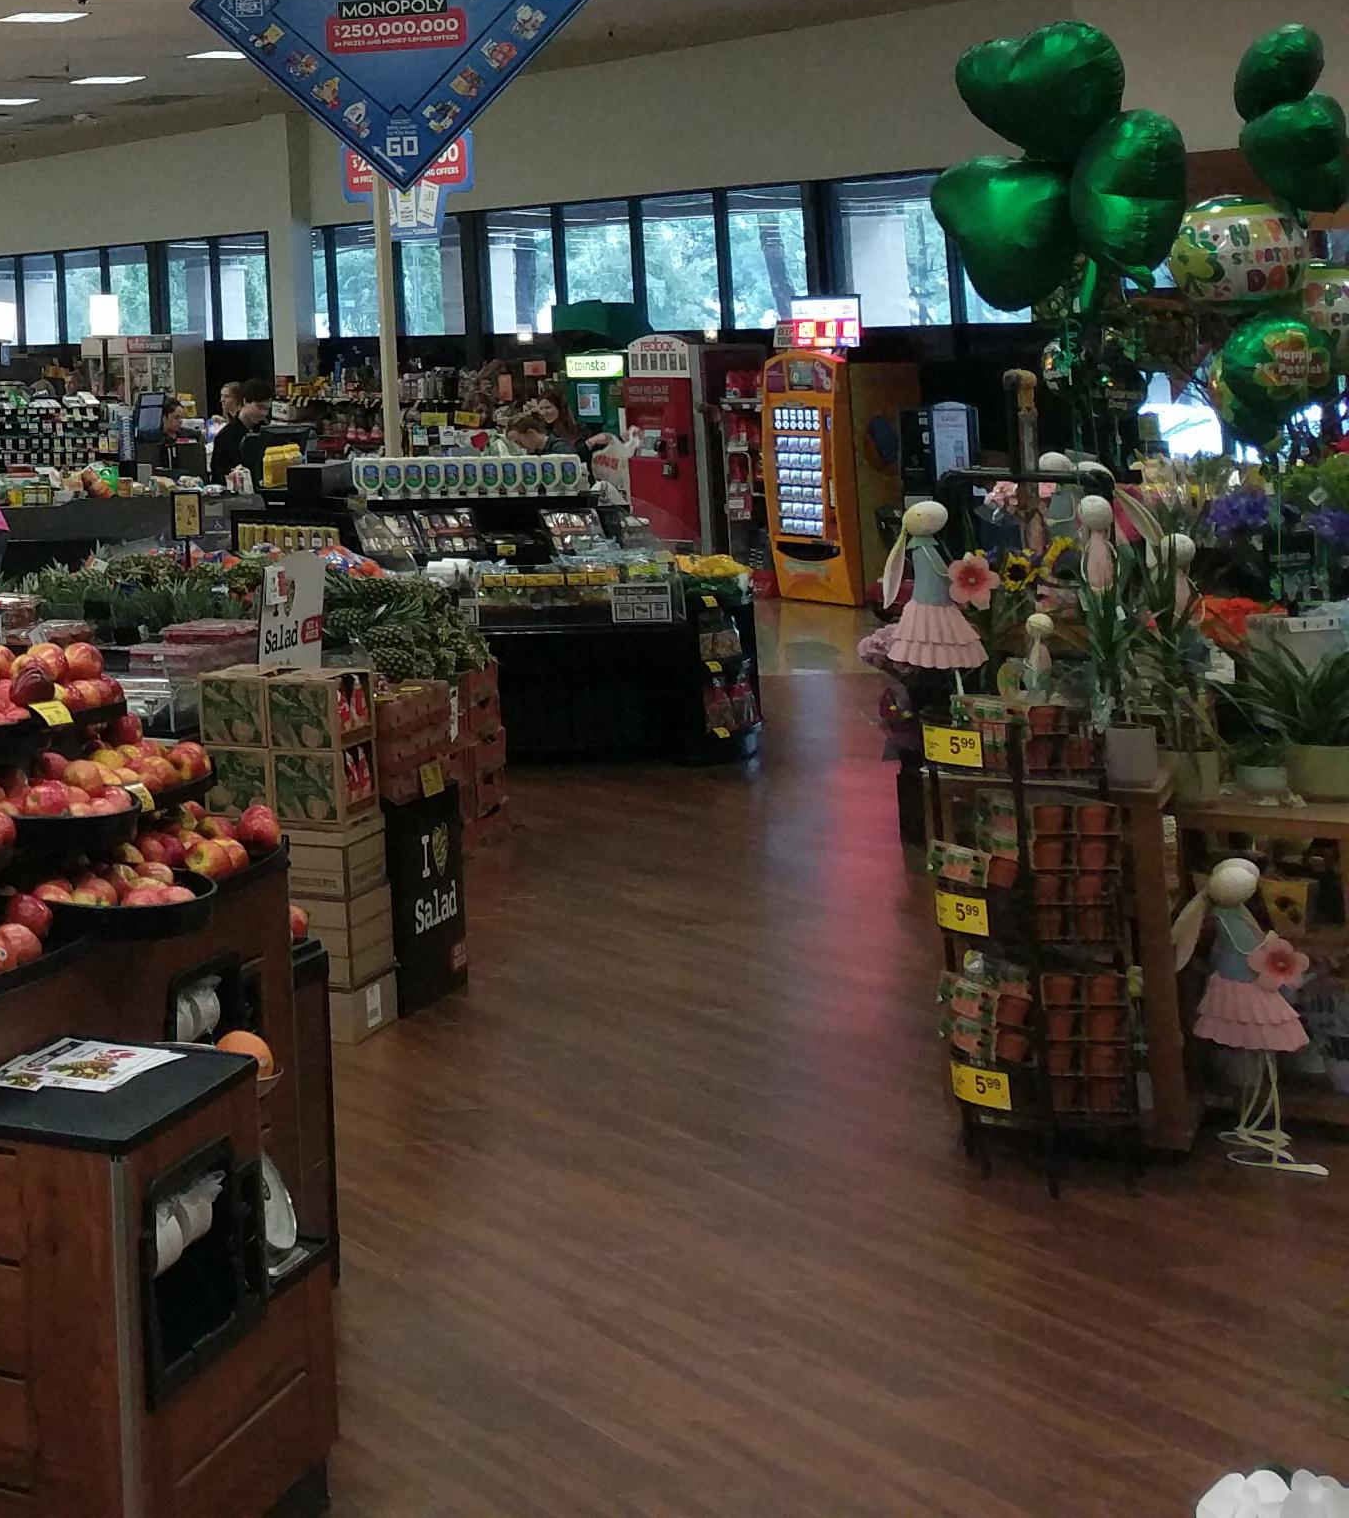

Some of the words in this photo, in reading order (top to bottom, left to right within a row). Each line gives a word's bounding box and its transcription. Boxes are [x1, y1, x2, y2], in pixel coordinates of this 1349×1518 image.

[385, 135, 419, 157] GO
[264, 620, 299, 655] Salad
[420, 834, 431, 879] I
[414, 879, 458, 935] Salad
